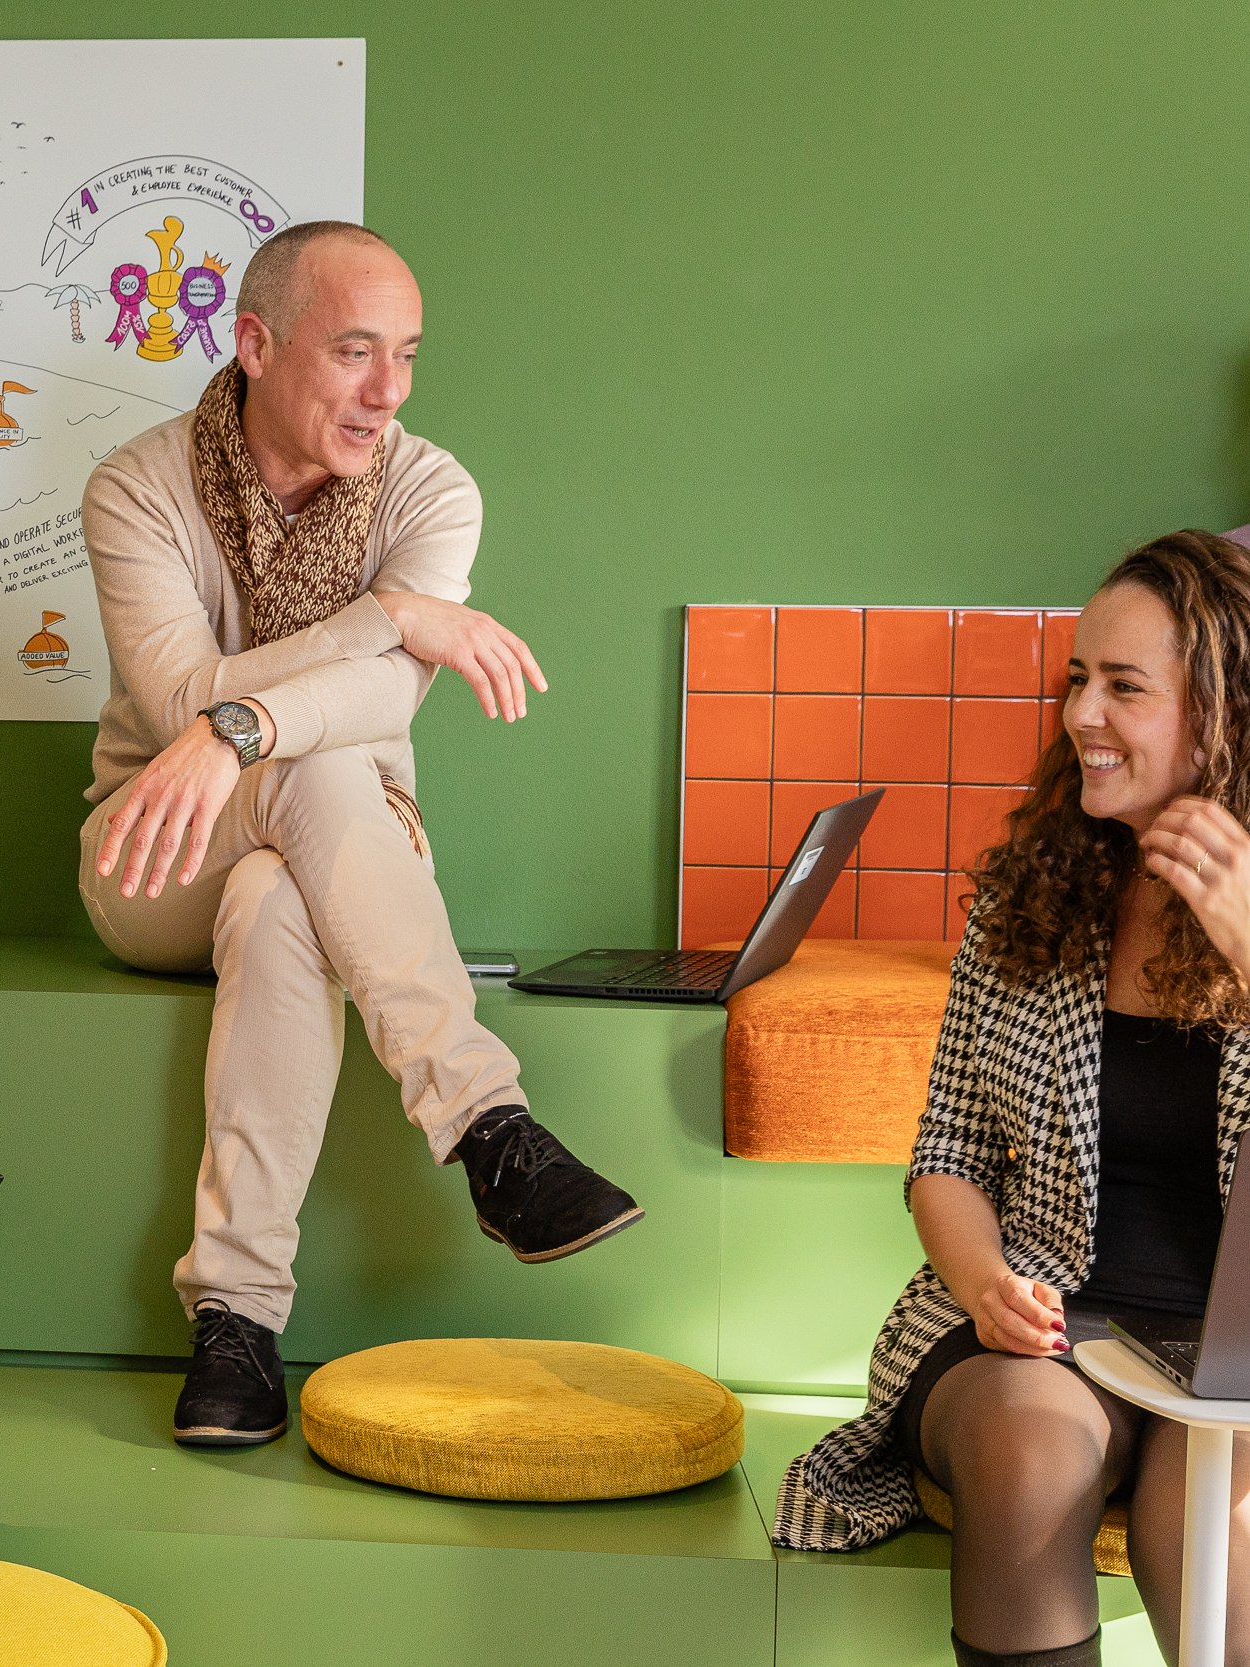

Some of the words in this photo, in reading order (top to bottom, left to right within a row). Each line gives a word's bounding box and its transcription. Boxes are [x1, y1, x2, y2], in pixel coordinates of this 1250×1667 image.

[94, 180, 105, 194] IN
[108, 166, 152, 188] CREATING
[156, 164, 176, 175] THE
[184, 164, 209, 177] BEST
[214, 173, 253, 198] CUSTOMER
[141, 181, 181, 194] EMPLOYEE
[187, 182, 234, 207] EXPERIENCE
[121, 281, 137, 291] 500
[14, 519, 52, 545] OPERATE
[3, 558, 10, 566] A
[13, 544, 50, 562] DIGITAL
[8, 571, 19, 581] TO
[23, 557, 58, 575] CREATE
[63, 549, 77, 560] AN
[4, 583, 17, 594] AND
[21, 574, 49, 588] DELIVER
[51, 559, 89, 578] EXCITING
[20, 652, 44, 660] ADDED
[45, 651, 65, 660] VALUE
